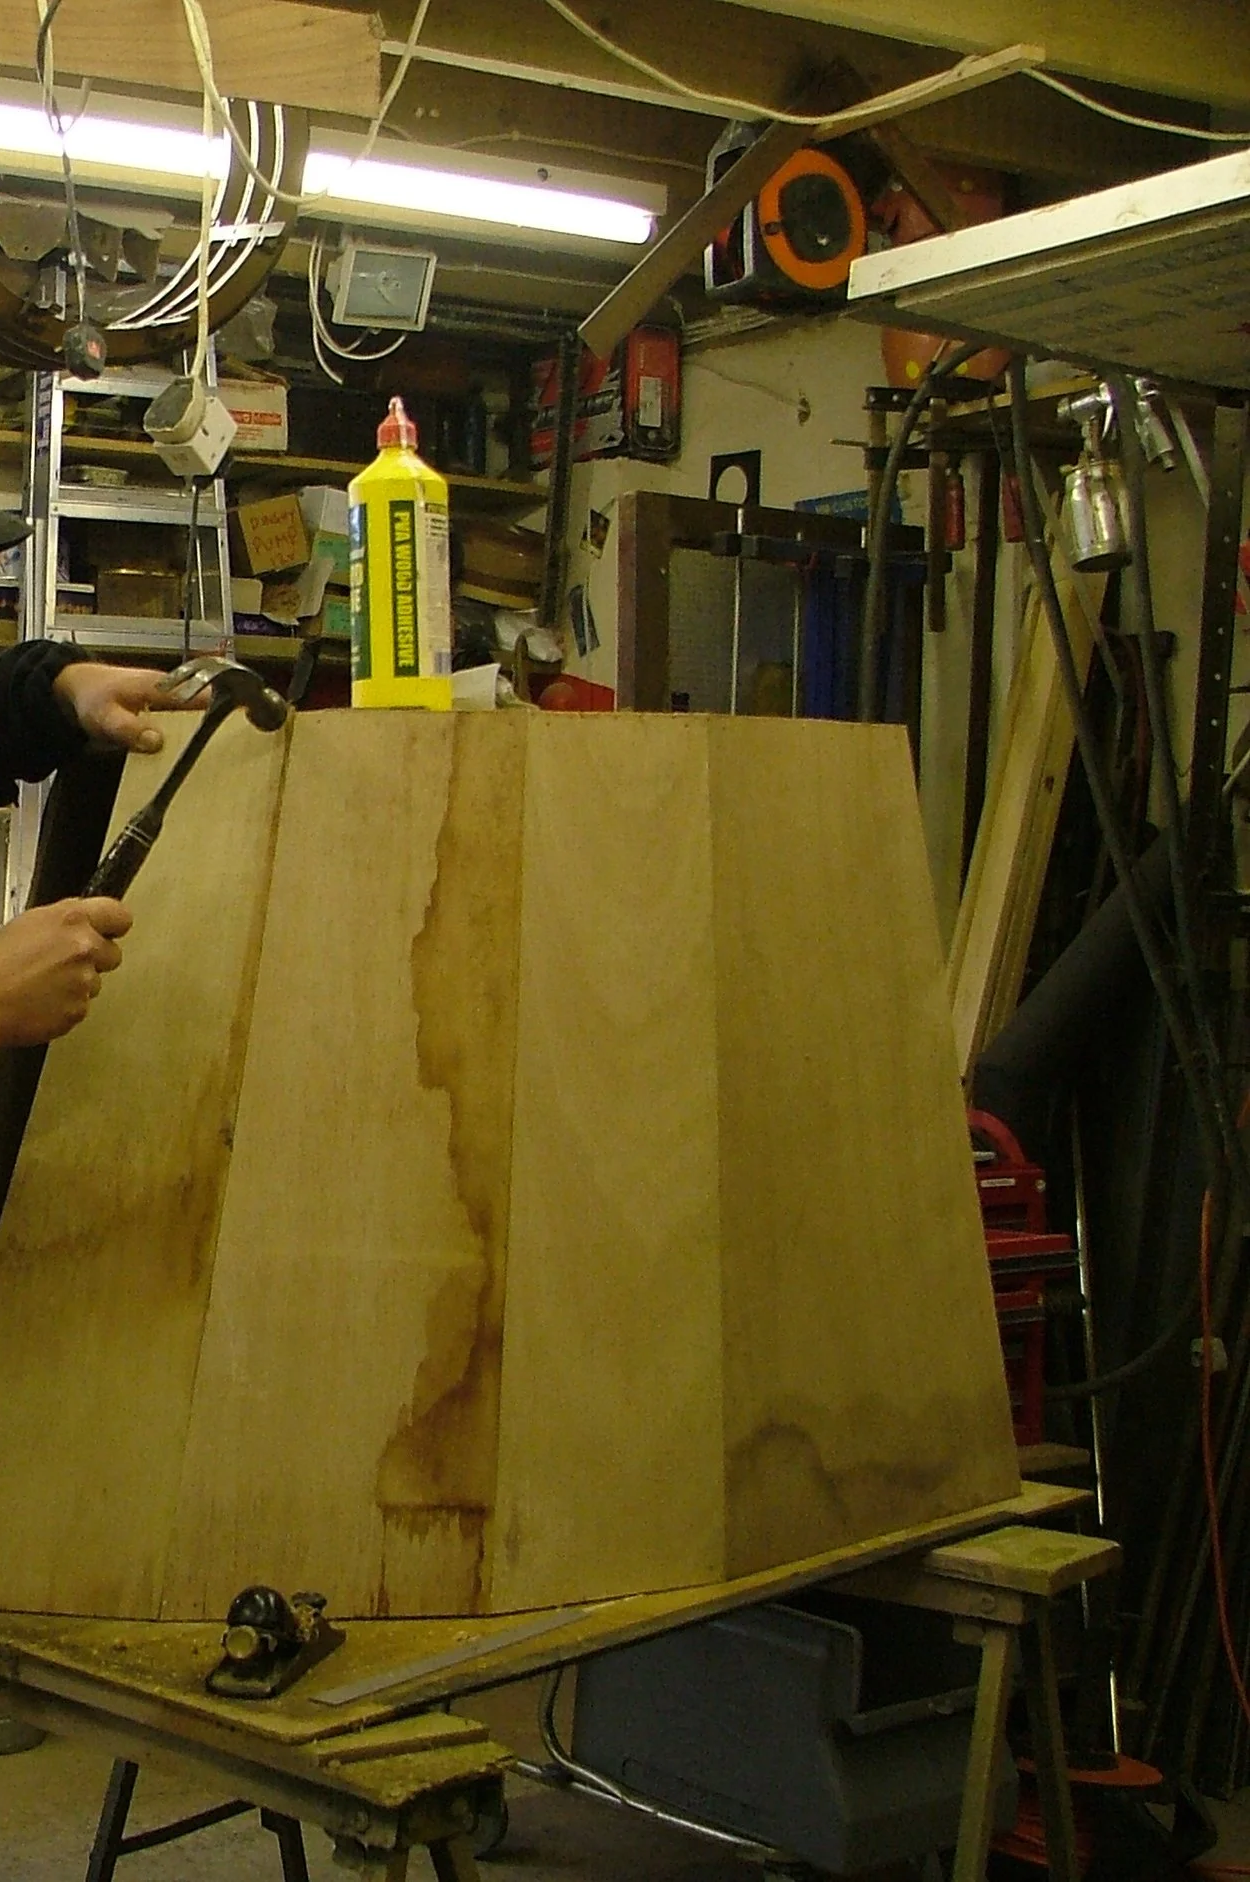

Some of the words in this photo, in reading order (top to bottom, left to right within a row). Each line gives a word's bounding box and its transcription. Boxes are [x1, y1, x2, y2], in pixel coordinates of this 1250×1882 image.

[394, 511, 411, 541] PVA
[395, 544, 412, 591] WOOD
[396, 594, 415, 668] ADHESIVE
